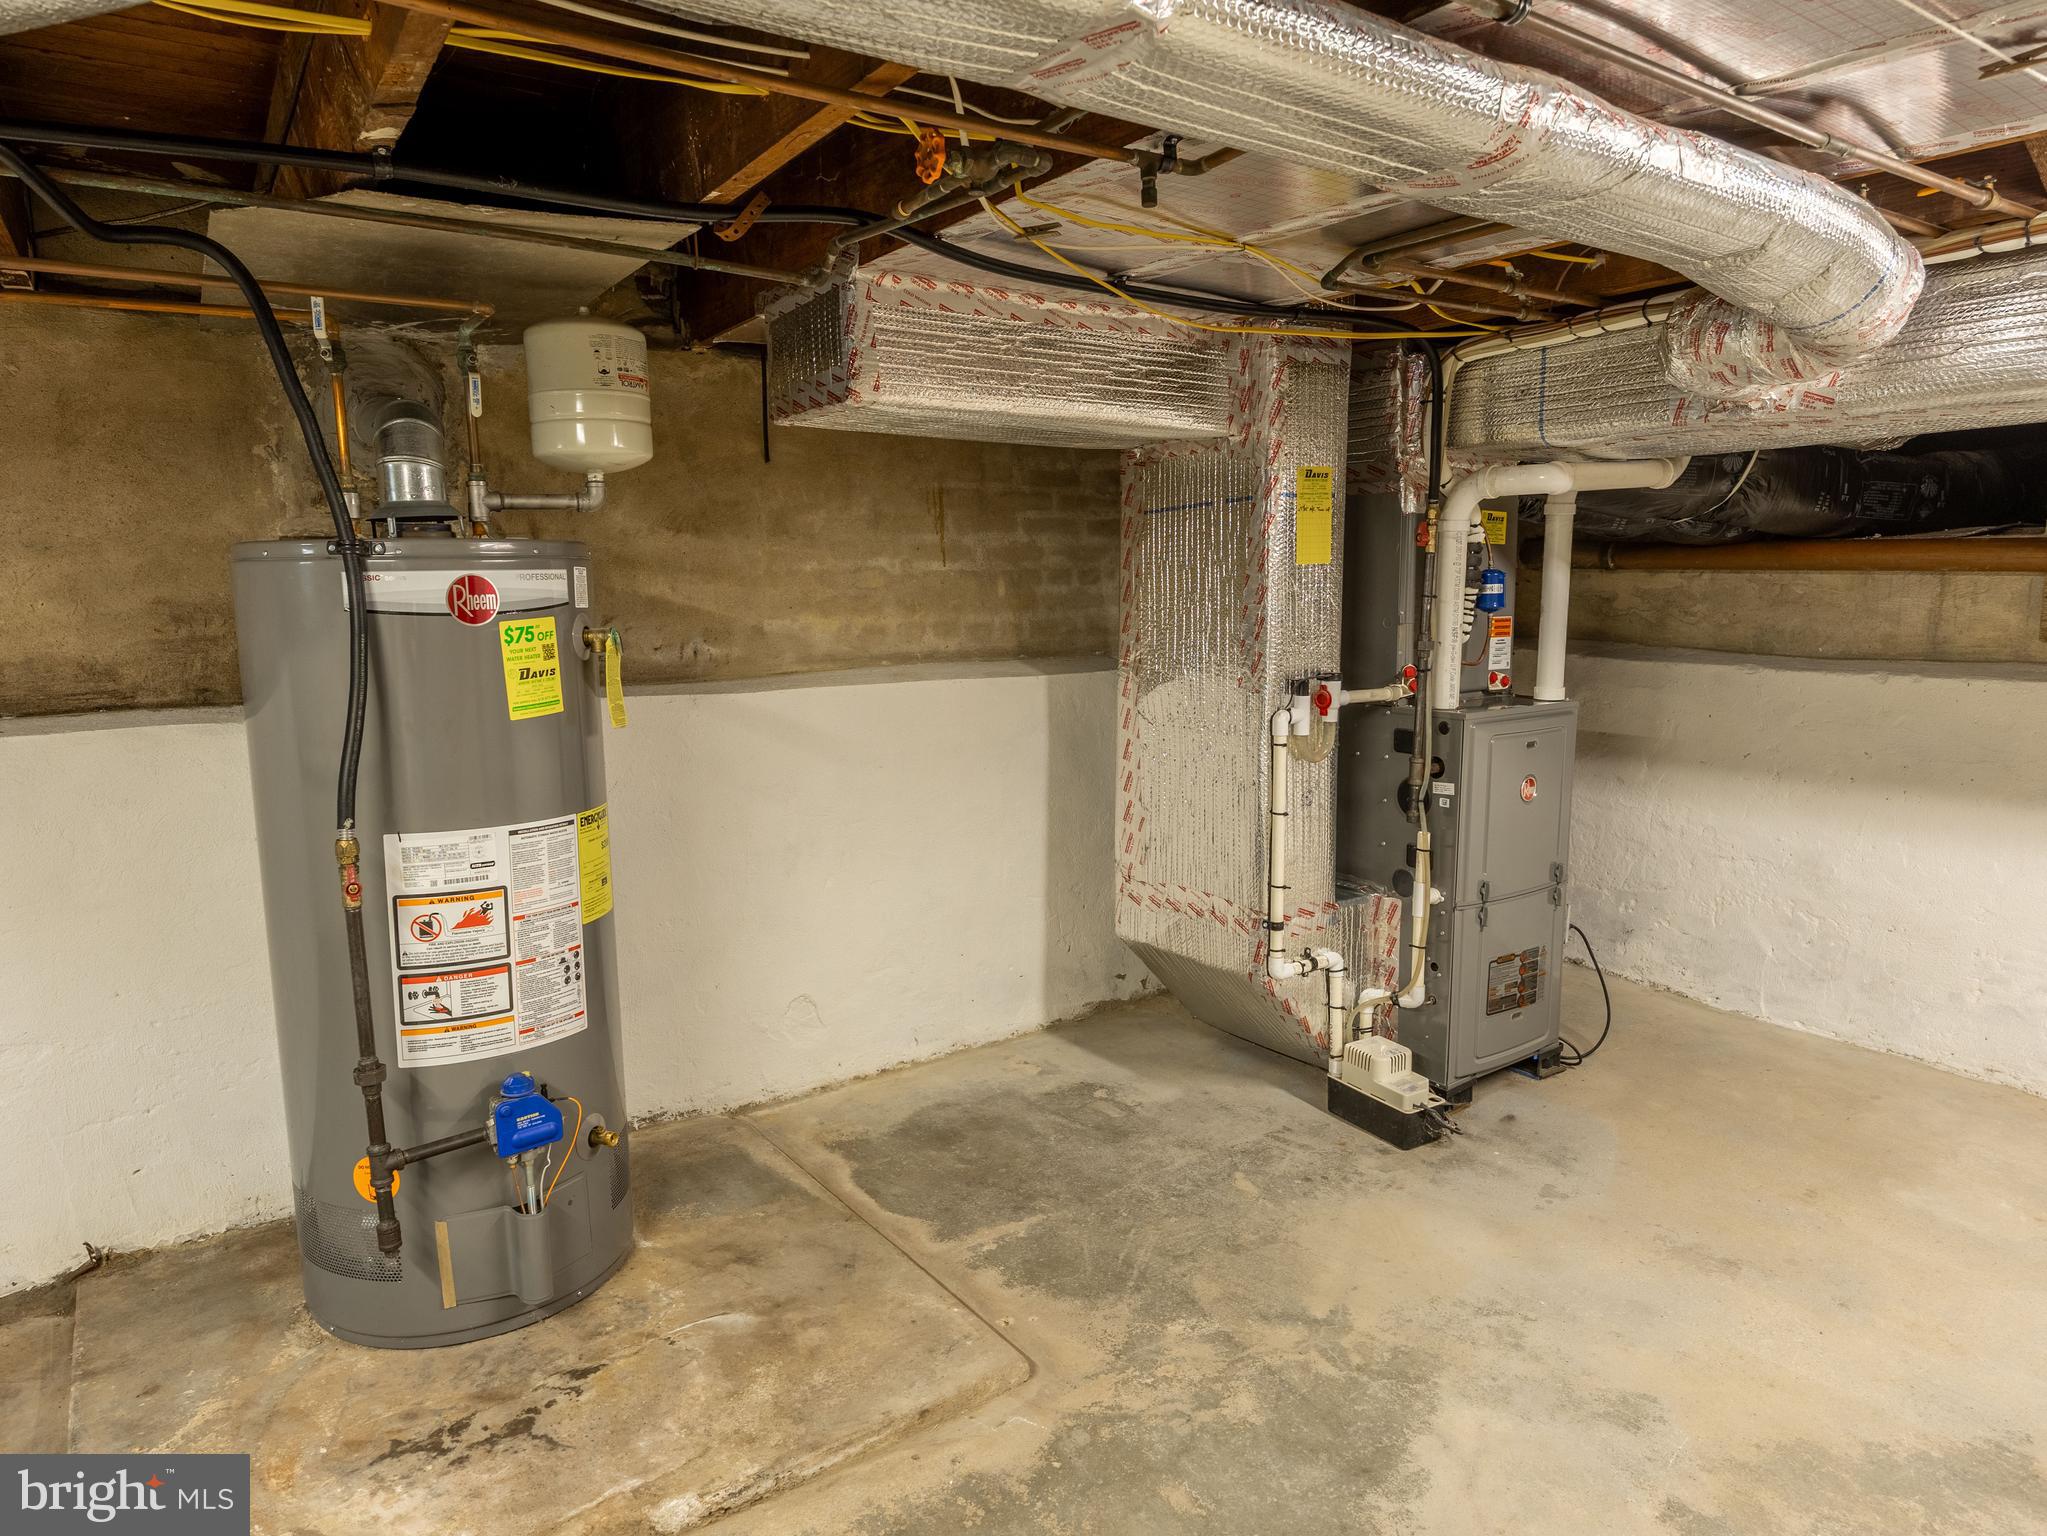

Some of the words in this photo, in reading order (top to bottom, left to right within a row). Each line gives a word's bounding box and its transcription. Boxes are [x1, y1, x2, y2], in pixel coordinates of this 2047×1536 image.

[1305, 469, 1329, 479] DAVIS
[453, 576, 497, 617] Rheem
[504, 625, 535, 646] $75
[537, 631, 554, 641] OFF
[509, 647, 524, 655] YOUR
[518, 667, 556, 680] DAVIS
[437, 894, 475, 904] WARNING
[443, 973, 473, 982] DANGER
[451, 1023, 477, 1033] WARNING
